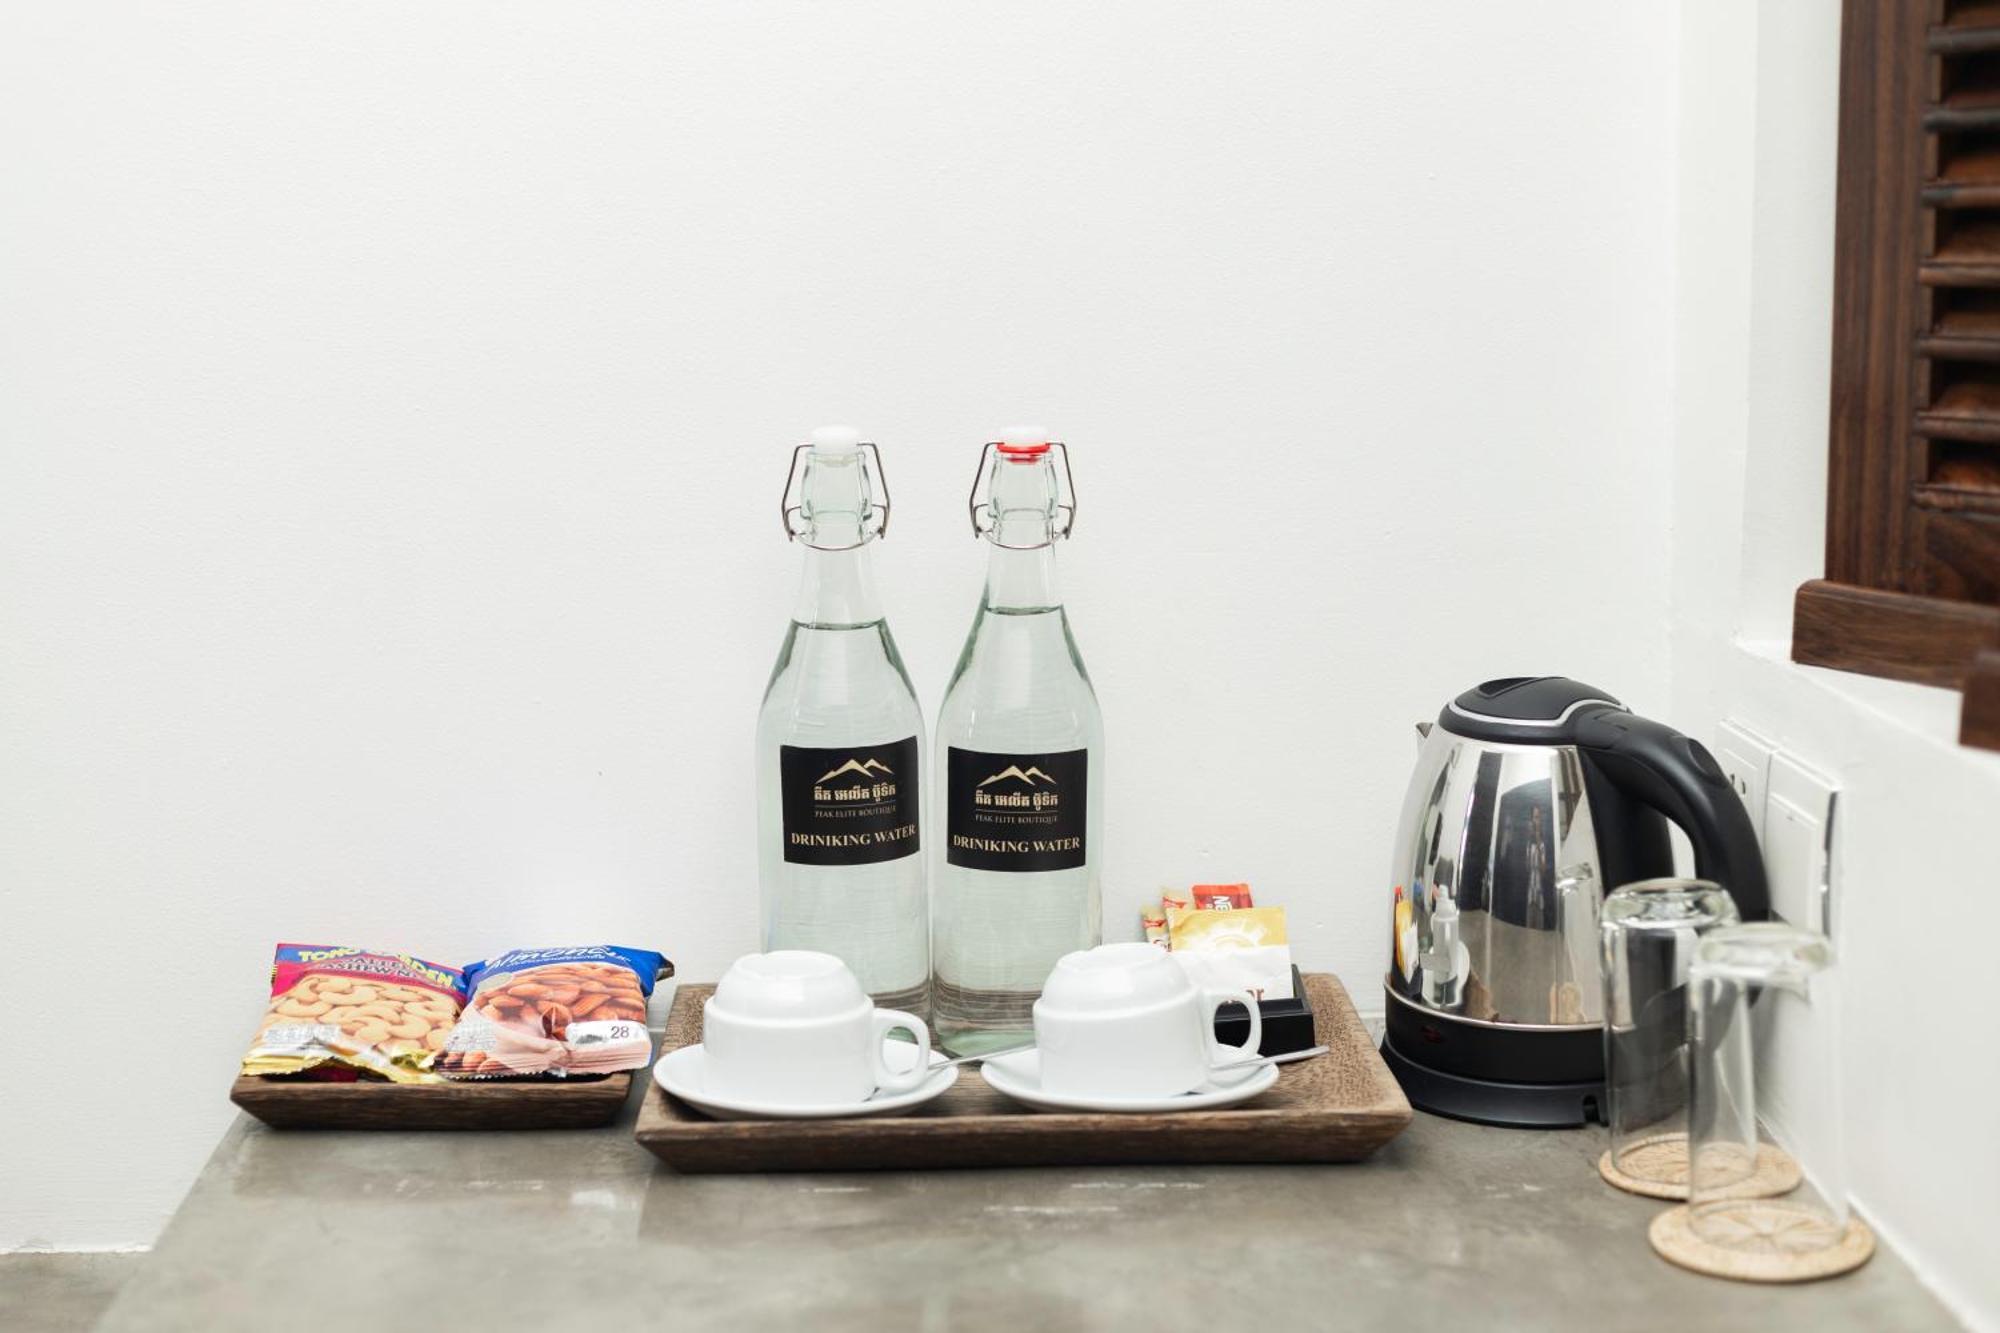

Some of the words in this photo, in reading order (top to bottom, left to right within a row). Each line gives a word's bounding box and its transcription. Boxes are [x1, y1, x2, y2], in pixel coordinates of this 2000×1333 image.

[815, 810, 834, 818] PEAK
[835, 809, 856, 818] ELITE
[858, 805, 897, 817] BOUTIQUE
[975, 814, 993, 822] PEAK
[995, 815, 1016, 823] ELITE
[1018, 815, 1058, 824] BOUTIQUE
[791, 832, 871, 847] DRINIKING
[875, 825, 917, 843] WATER
[953, 834, 1030, 853] DRINIKING
[1033, 836, 1081, 853] WATER
[610, 1025, 630, 1040] 28
